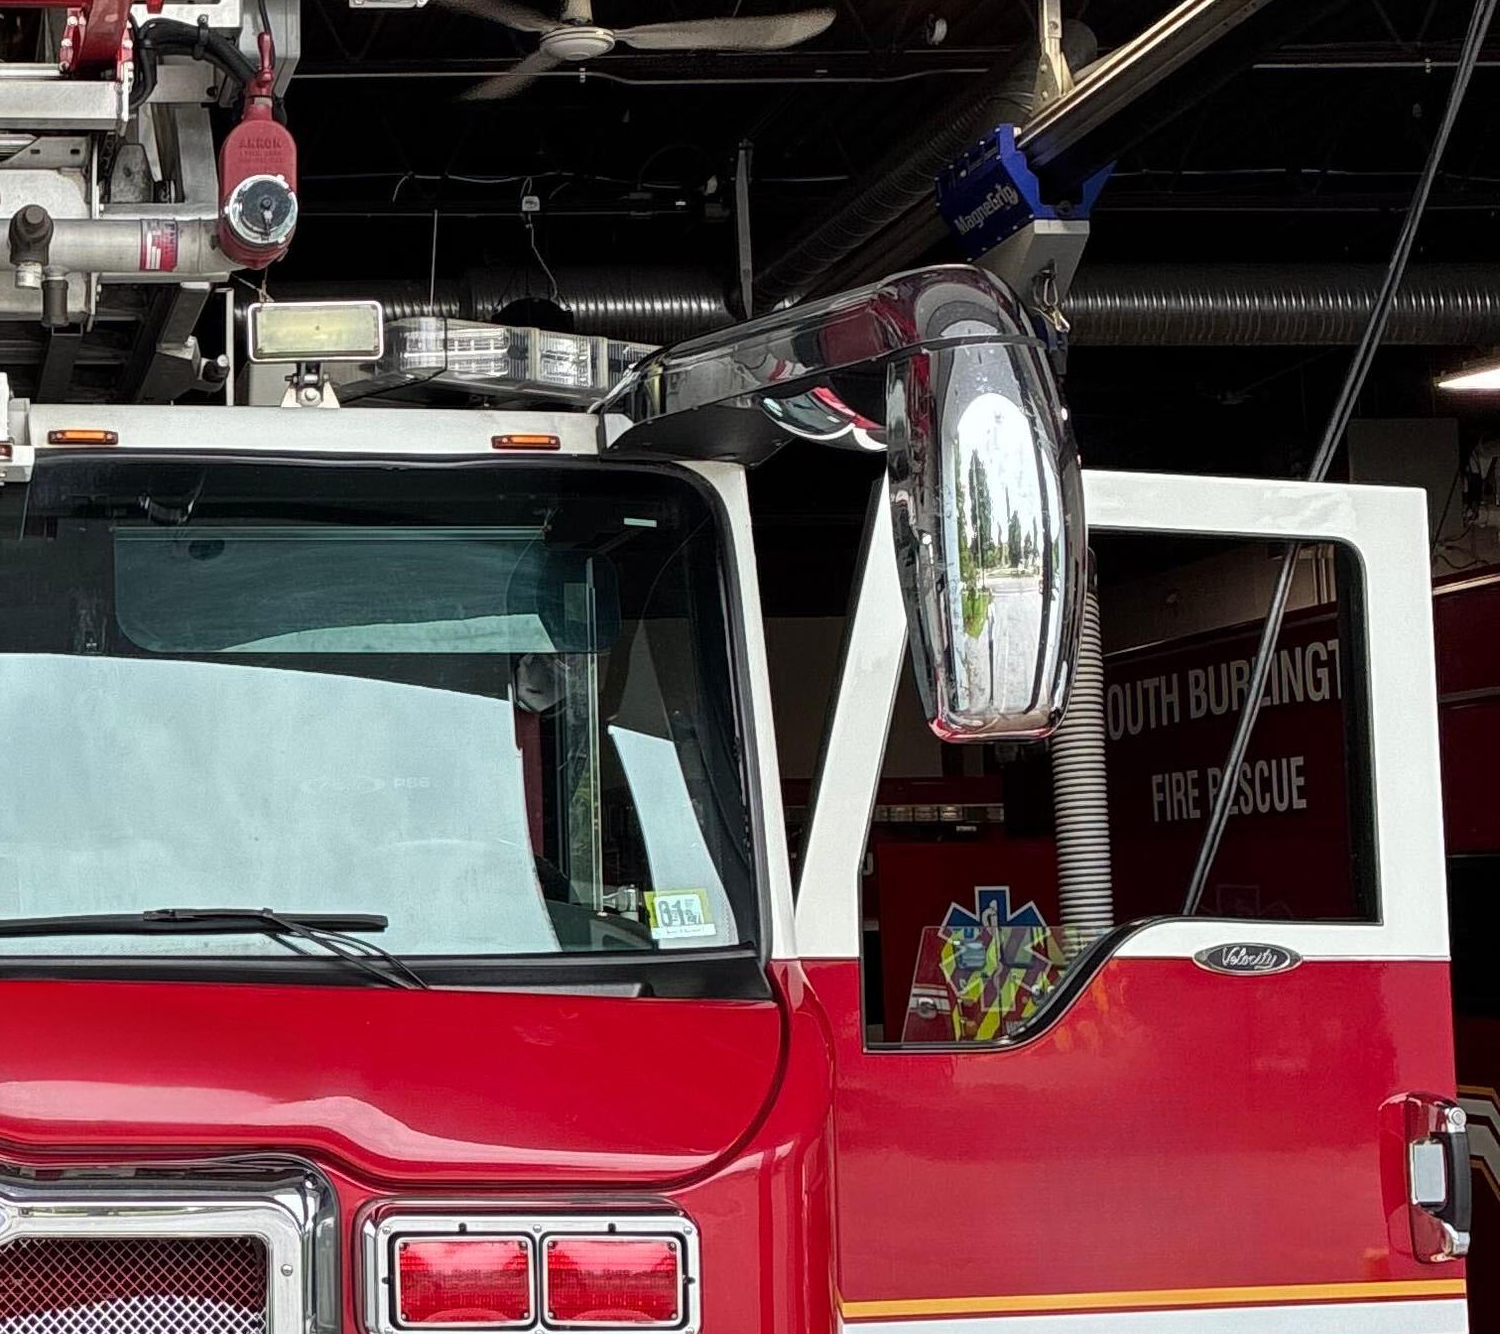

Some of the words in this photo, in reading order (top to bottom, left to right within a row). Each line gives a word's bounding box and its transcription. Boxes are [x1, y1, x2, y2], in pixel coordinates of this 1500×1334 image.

[954, 183, 1019, 236] MagneGrip
[1151, 770, 1201, 822] FIRE
[1222, 946, 1278, 970] Velocity
